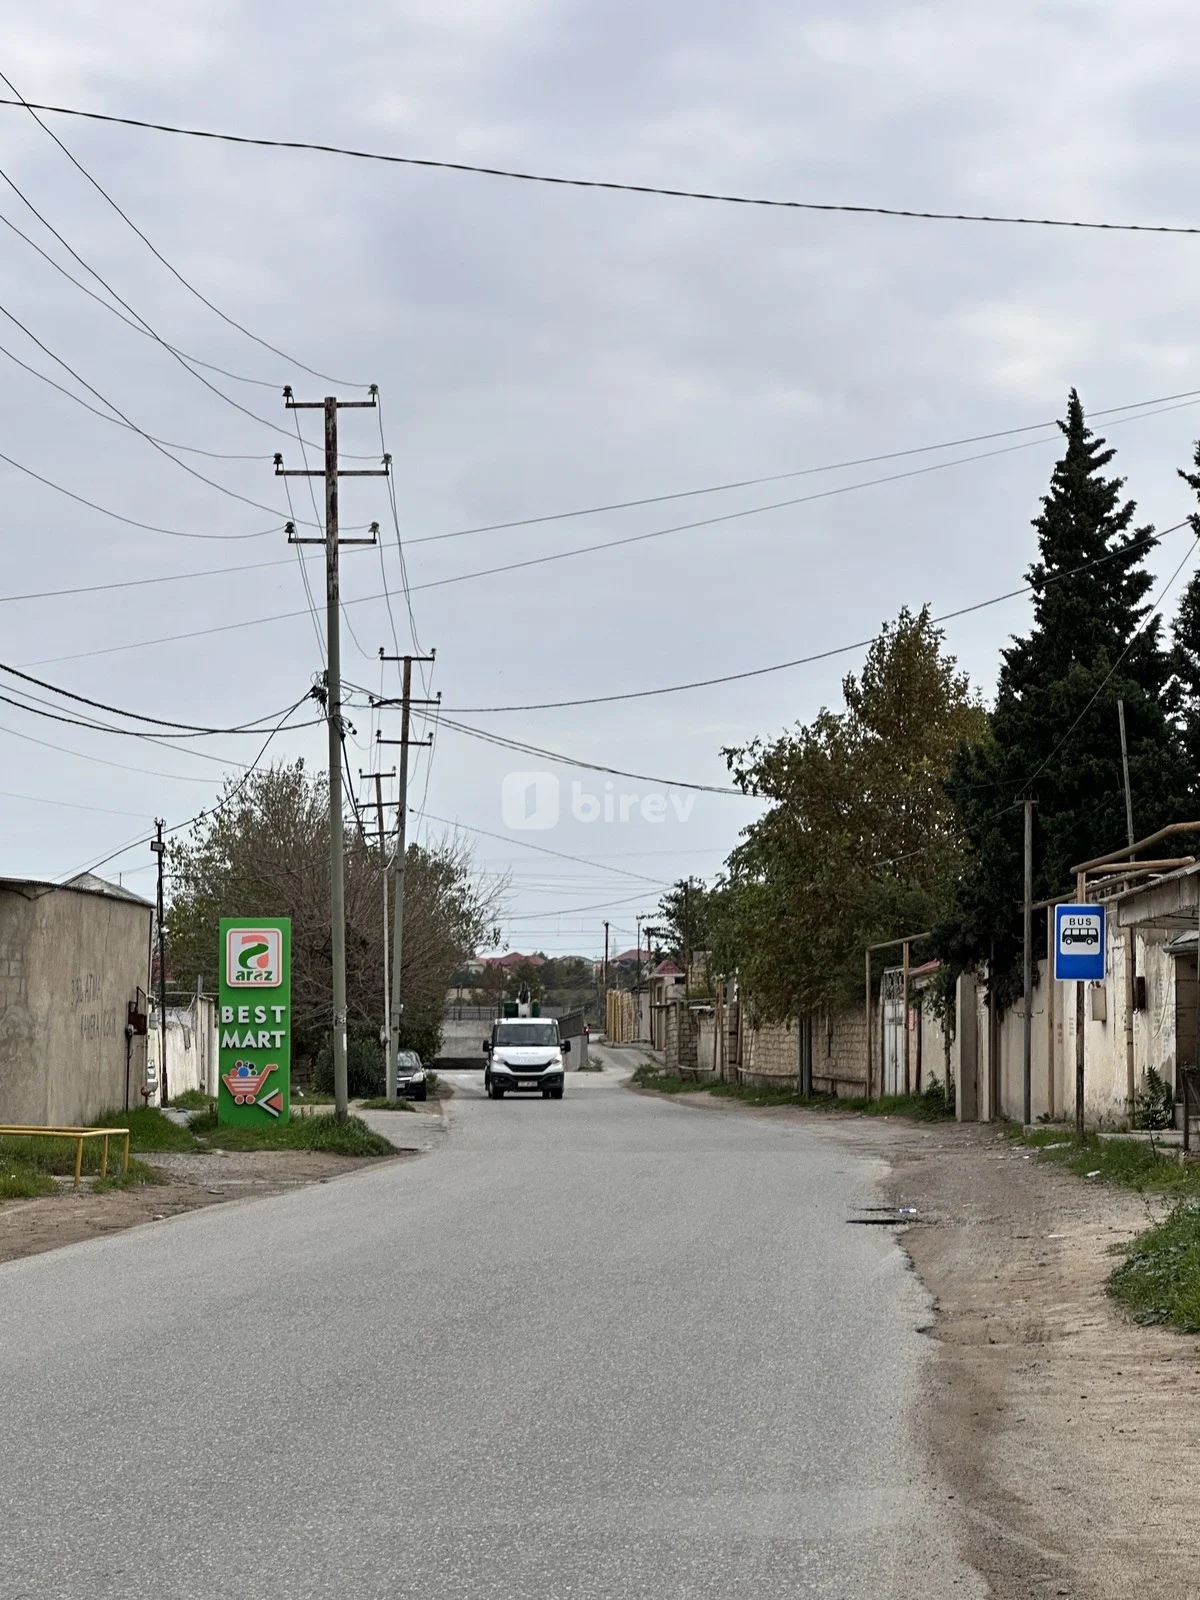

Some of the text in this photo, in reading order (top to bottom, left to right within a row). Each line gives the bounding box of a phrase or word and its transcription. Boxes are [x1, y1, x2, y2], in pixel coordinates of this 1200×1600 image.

[1069, 917, 1092, 926] BUS
[235, 969, 273, 982] araz
[221, 1005, 286, 1024] BEST
[221, 1030, 286, 1048] MART
